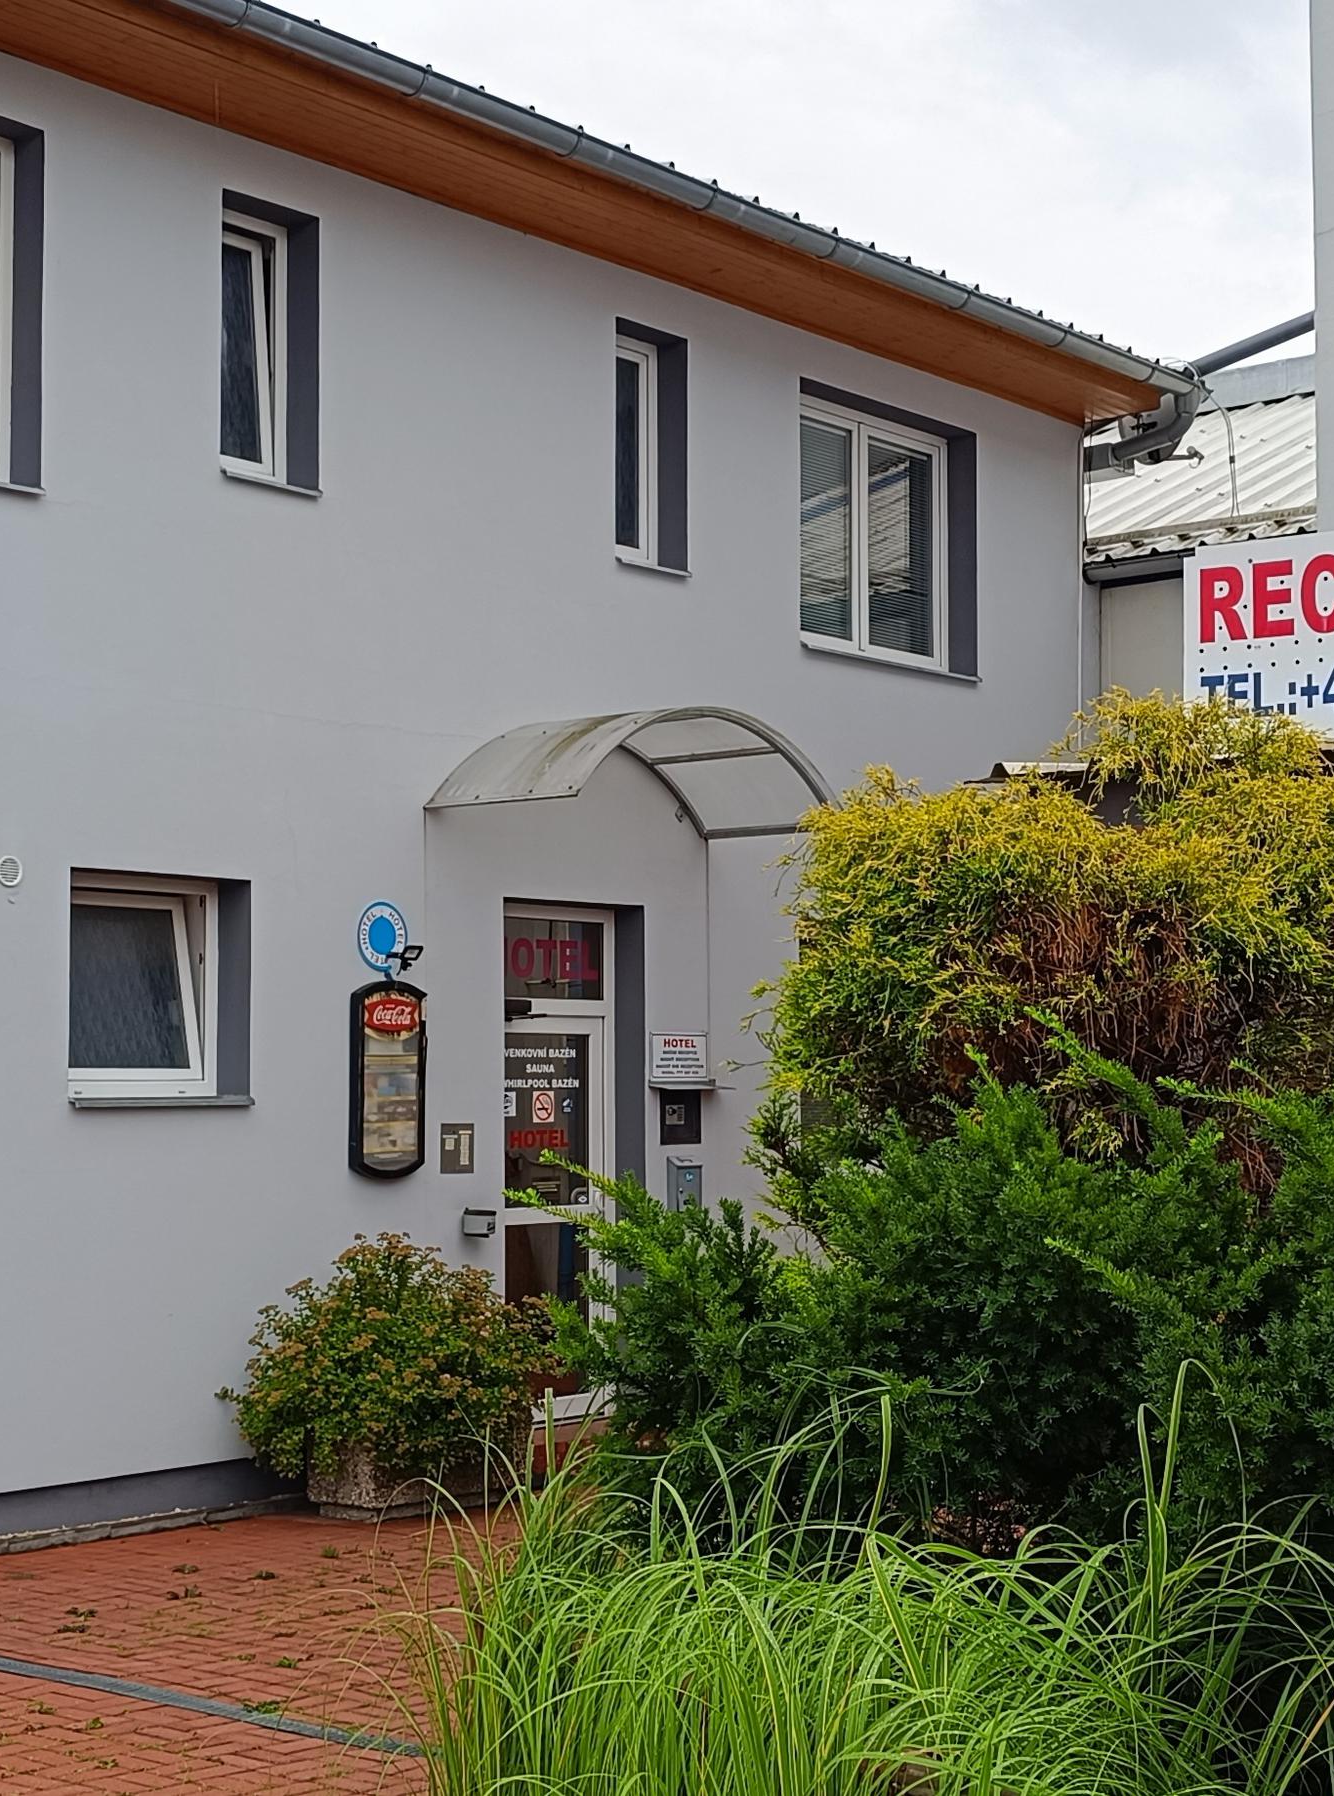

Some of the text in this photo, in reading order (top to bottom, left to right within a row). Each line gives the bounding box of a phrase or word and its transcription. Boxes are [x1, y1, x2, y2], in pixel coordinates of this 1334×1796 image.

[505, 937, 599, 980] OTEL
[663, 1038, 697, 1048] HOTEL
[525, 1063, 555, 1073] SAUNA
[509, 1127, 570, 1149] HOTEL
